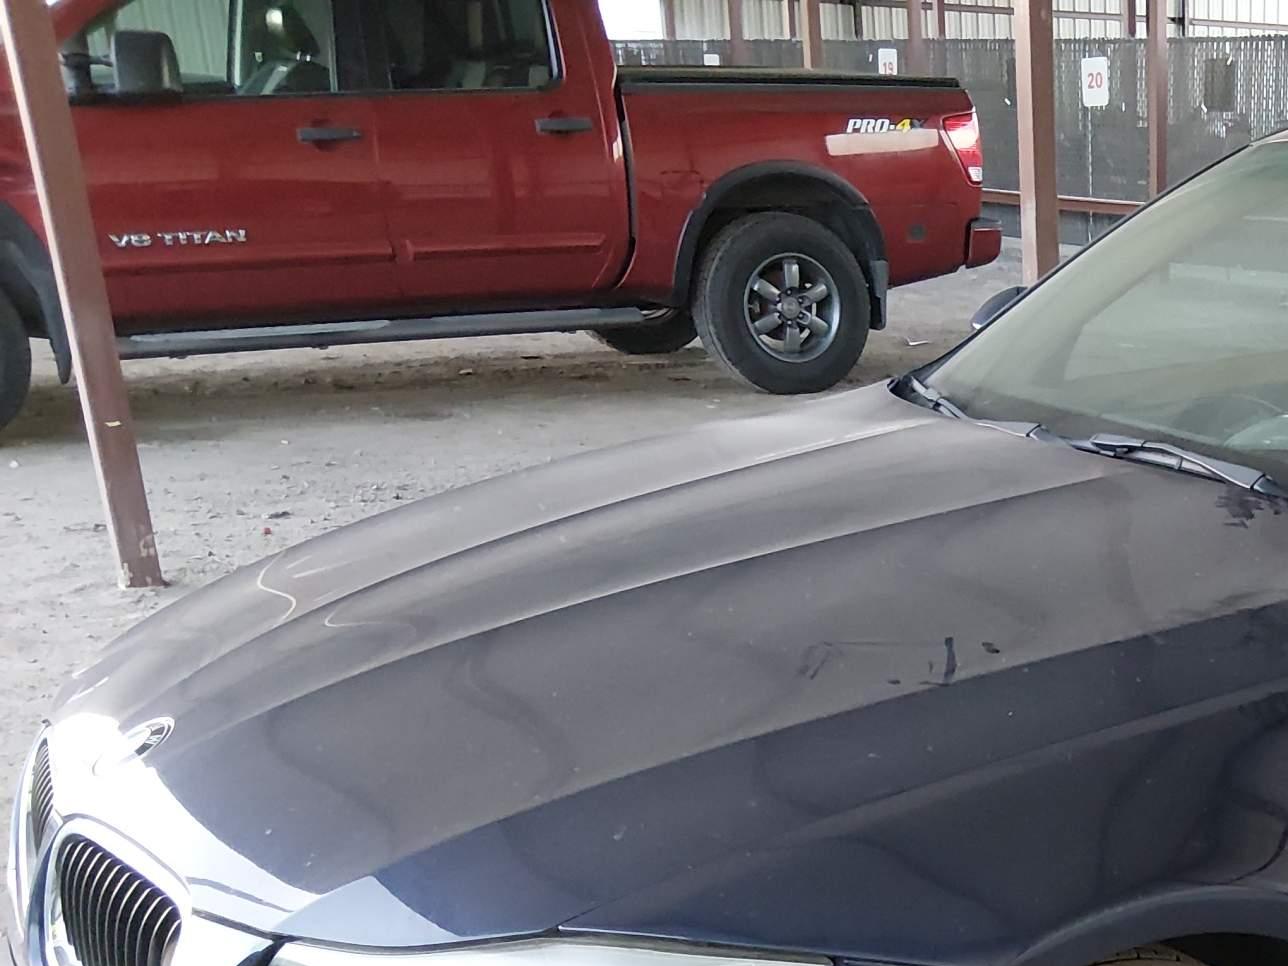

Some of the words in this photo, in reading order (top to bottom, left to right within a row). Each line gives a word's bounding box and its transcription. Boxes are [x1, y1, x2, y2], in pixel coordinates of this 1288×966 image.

[1087, 71, 1104, 89] 20
[108, 233, 152, 248] V8
[156, 229, 247, 246] TITAN
